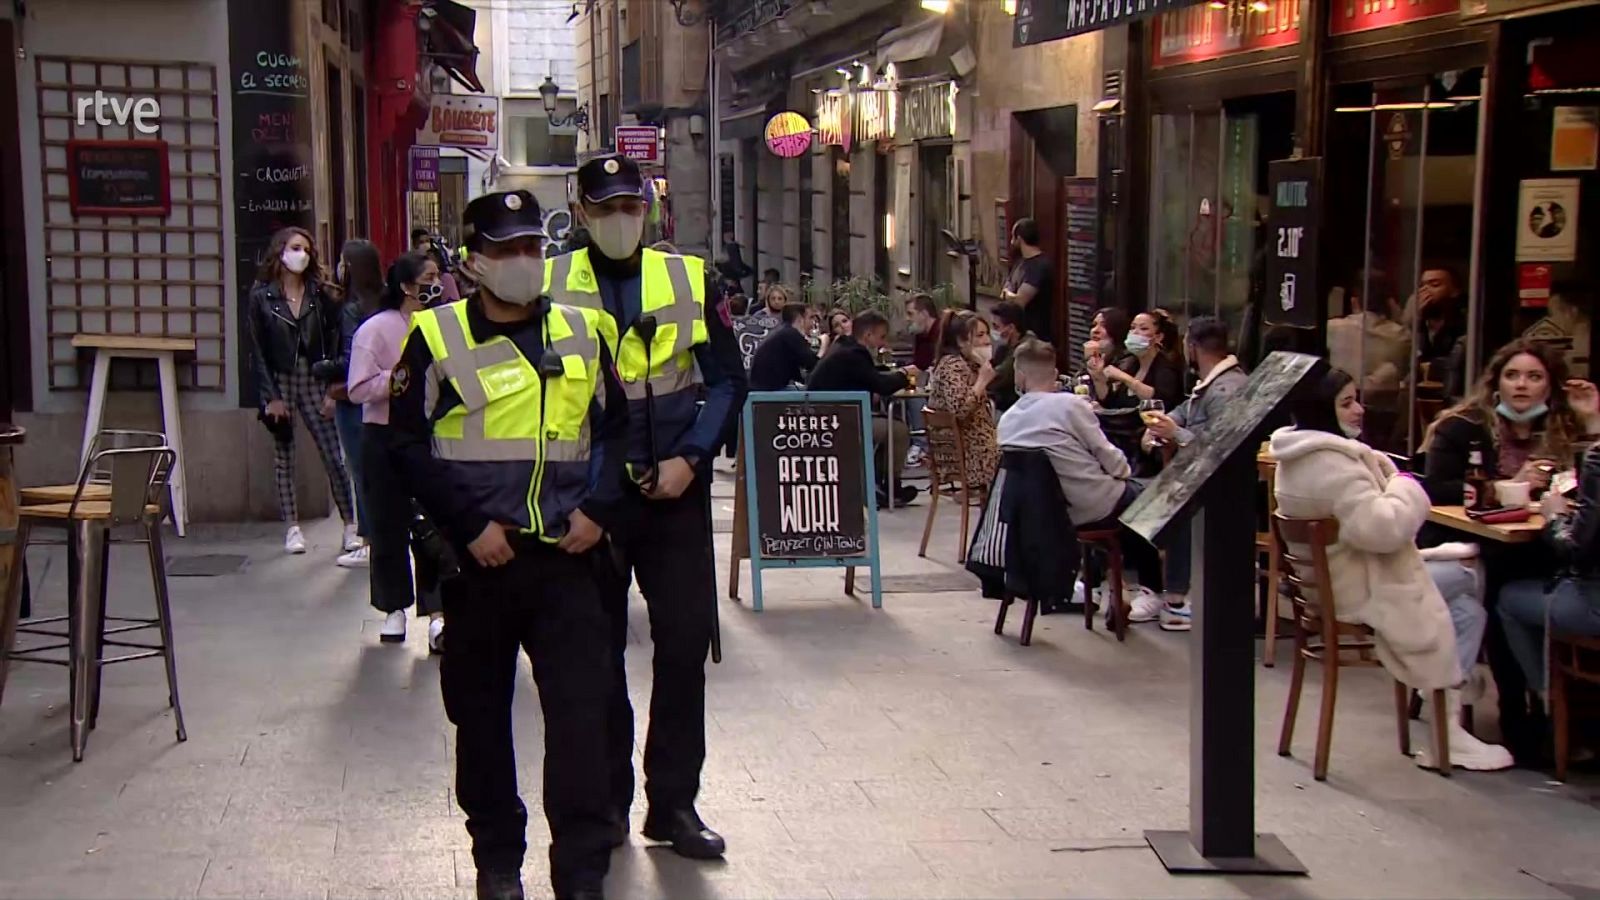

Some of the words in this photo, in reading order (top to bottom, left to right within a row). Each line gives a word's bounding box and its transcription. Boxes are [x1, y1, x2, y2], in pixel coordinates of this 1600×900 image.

[241, 72, 257, 88] EL
[788, 416, 829, 430] HERE
[772, 432, 834, 450] COPAS
[778, 456, 839, 482] AFTER
[779, 484, 840, 533] WORK
